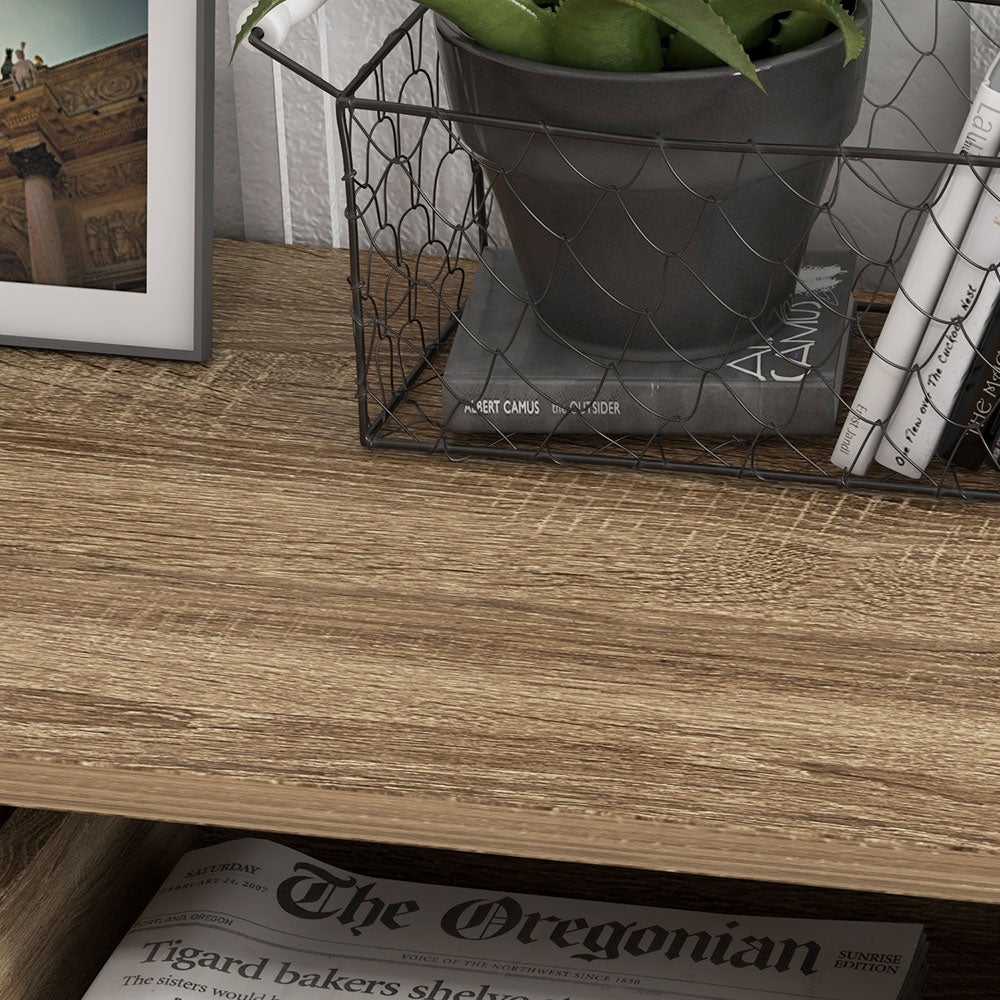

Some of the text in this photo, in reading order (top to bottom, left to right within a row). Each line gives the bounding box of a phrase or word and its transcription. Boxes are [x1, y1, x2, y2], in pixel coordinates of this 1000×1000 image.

[927, 367, 943, 387] The
[960, 284, 977, 311] Nest
[503, 401, 540, 415] CAMUS
[569, 401, 621, 415] OUTSIDER
[840, 427, 857, 455] Jandl
[184, 862, 261, 879] SATURDAY
[242, 879, 269, 893] 2007
[190, 912, 234, 926] OREGON
[276, 862, 822, 977] The Oregonian
[837, 950, 903, 965] SUNRISE
[140, 939, 270, 981] Tigard
[273, 962, 402, 998] bakers
[401, 953, 642, 986] VOICE OF THE NORTHWEST SINCE 1850
[833, 960, 900, 975] EDITION
[121, 974, 155, 987] The
[155, 974, 210, 994] sisters
